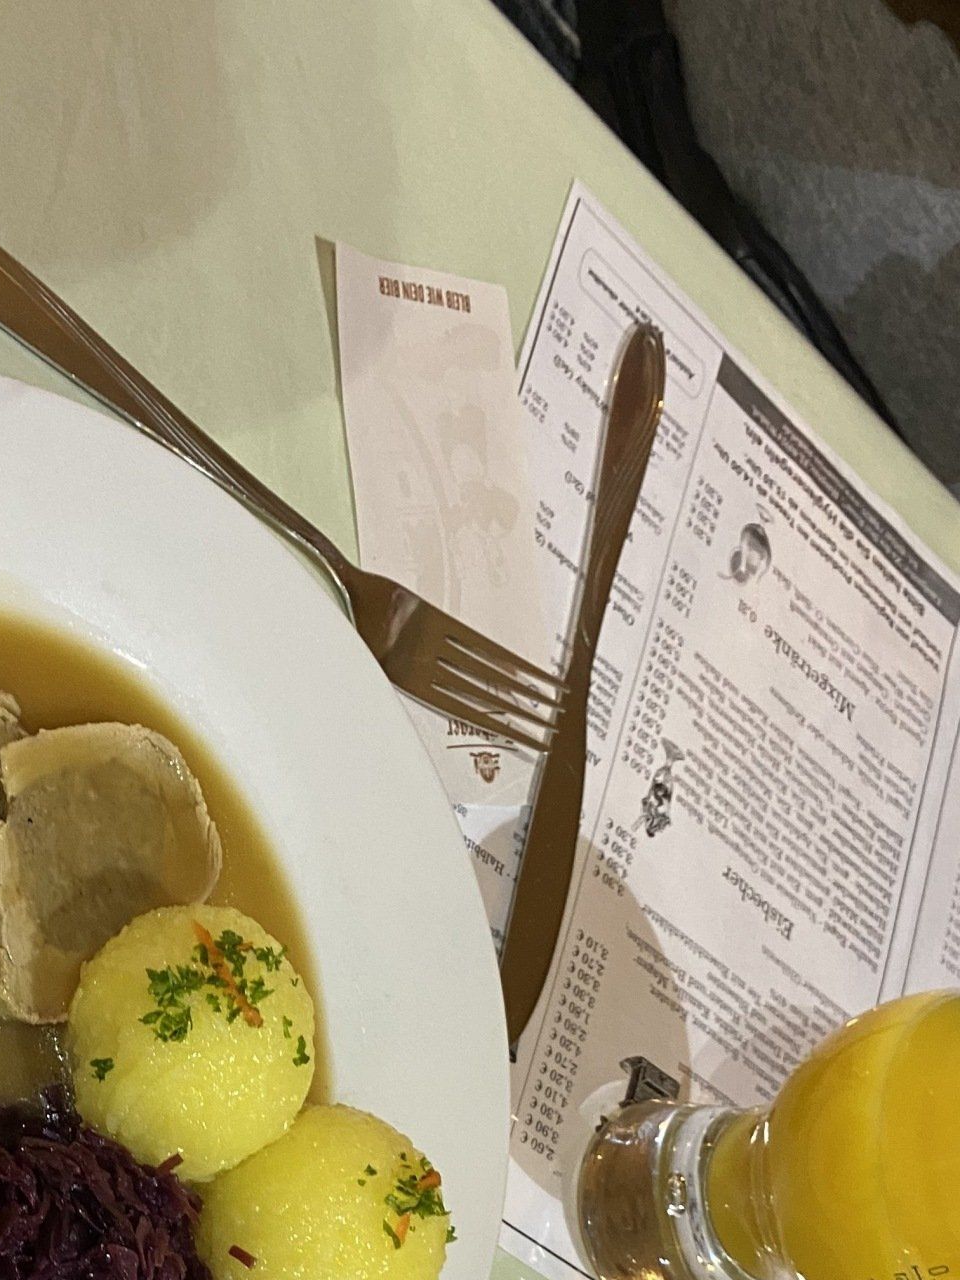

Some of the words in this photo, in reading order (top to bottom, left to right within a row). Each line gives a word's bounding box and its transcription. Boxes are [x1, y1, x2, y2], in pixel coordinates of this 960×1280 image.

[378, 276, 401, 300] BIER
[401, 281, 425, 304] DEIN
[426, 286, 444, 308] WIE
[761, 620, 855, 724] Mixgetränke
[720, 862, 794, 943] Eisbecher
[553, 1048, 578, 1076] 2,70
[548, 1065, 573, 1093] 3,20
[543, 1082, 569, 1110] 4,10
[539, 1099, 564, 1127] 4,30
[534, 1116, 559, 1144] 3,90
[529, 1133, 555, 1162] 2,60
